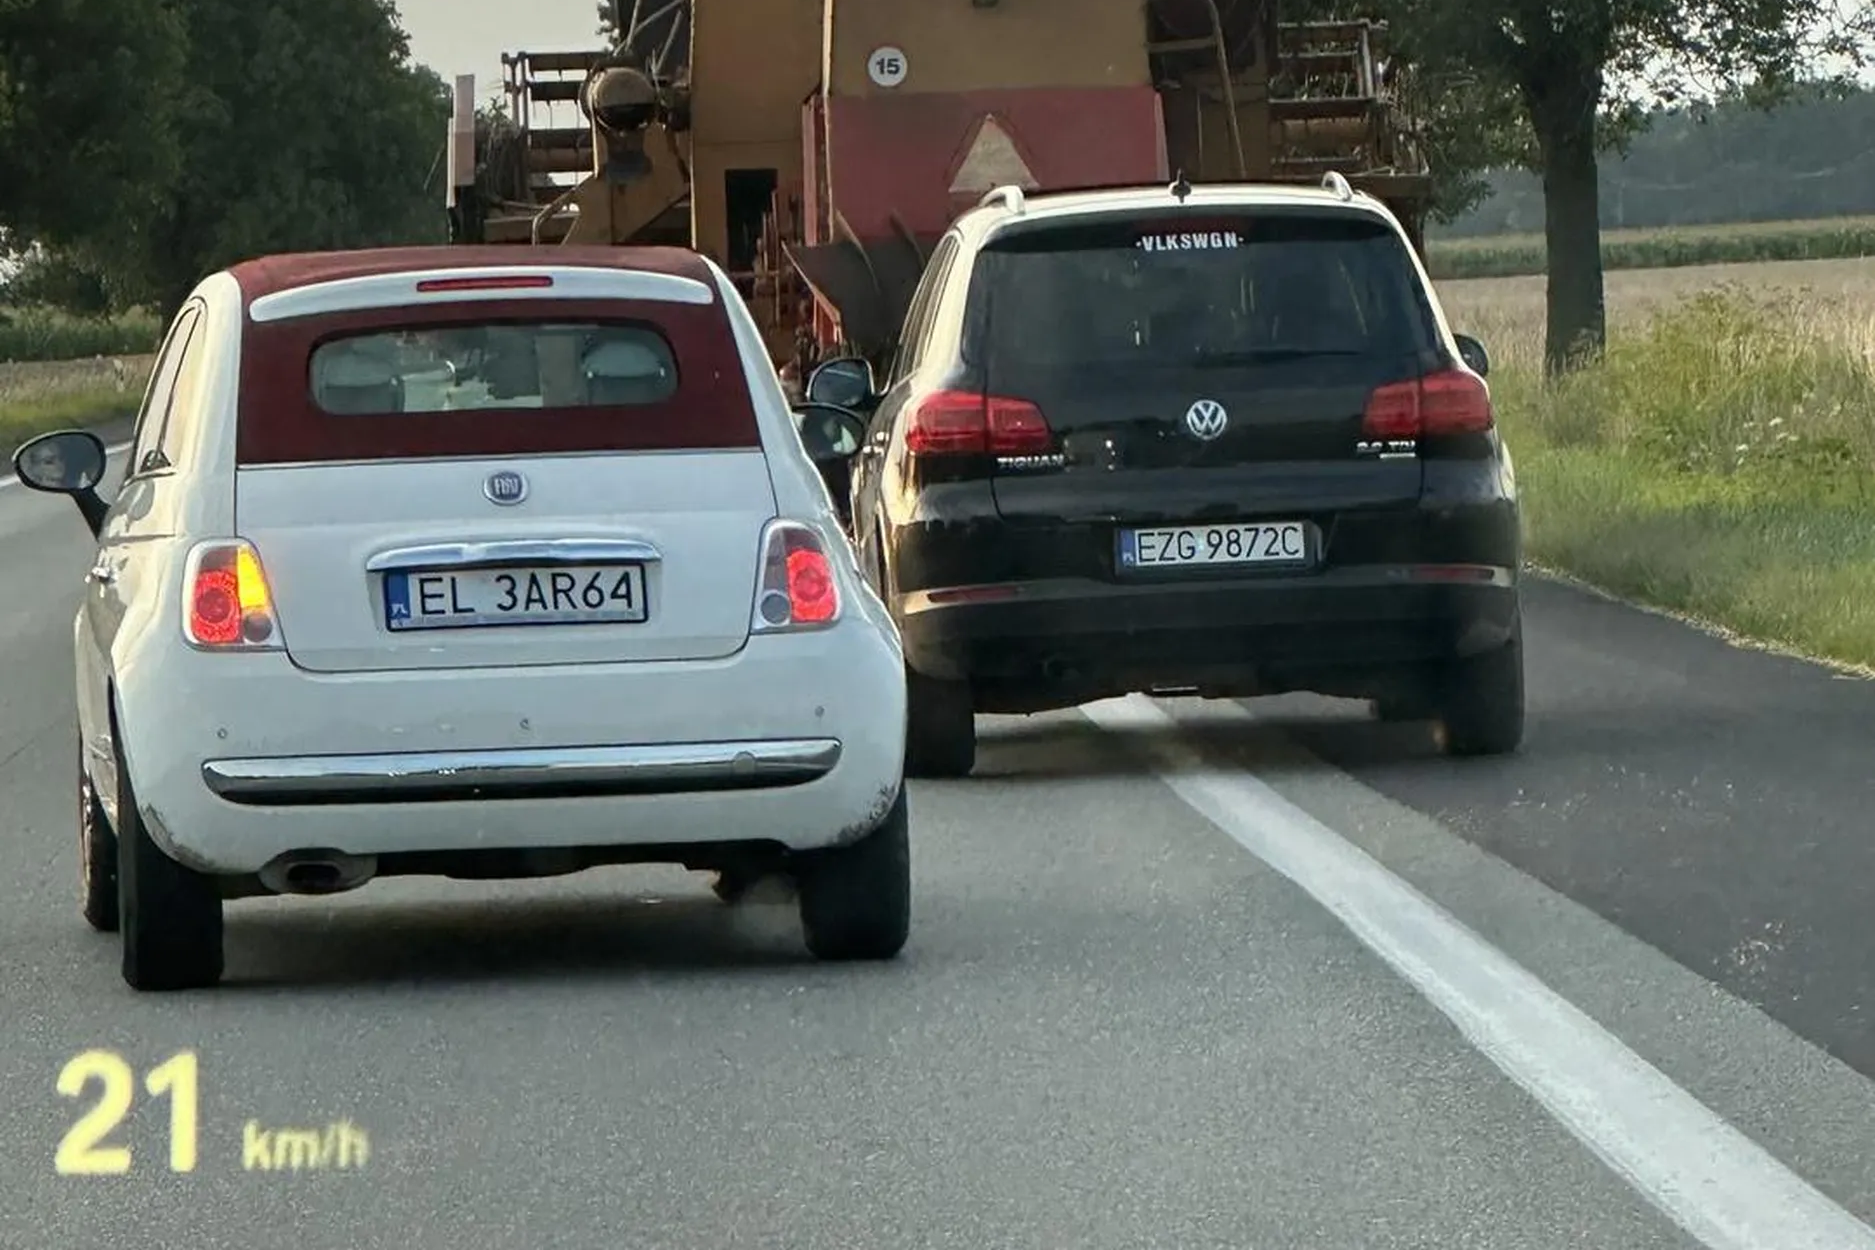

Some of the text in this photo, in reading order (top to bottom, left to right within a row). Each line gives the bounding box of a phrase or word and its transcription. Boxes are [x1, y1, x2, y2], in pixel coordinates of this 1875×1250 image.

[876, 58, 900, 75] 15
[1138, 526, 1299, 562] EZG 9872C
[419, 571, 634, 615] EL 3AR64
[54, 1049, 370, 1175] 21 km/h
